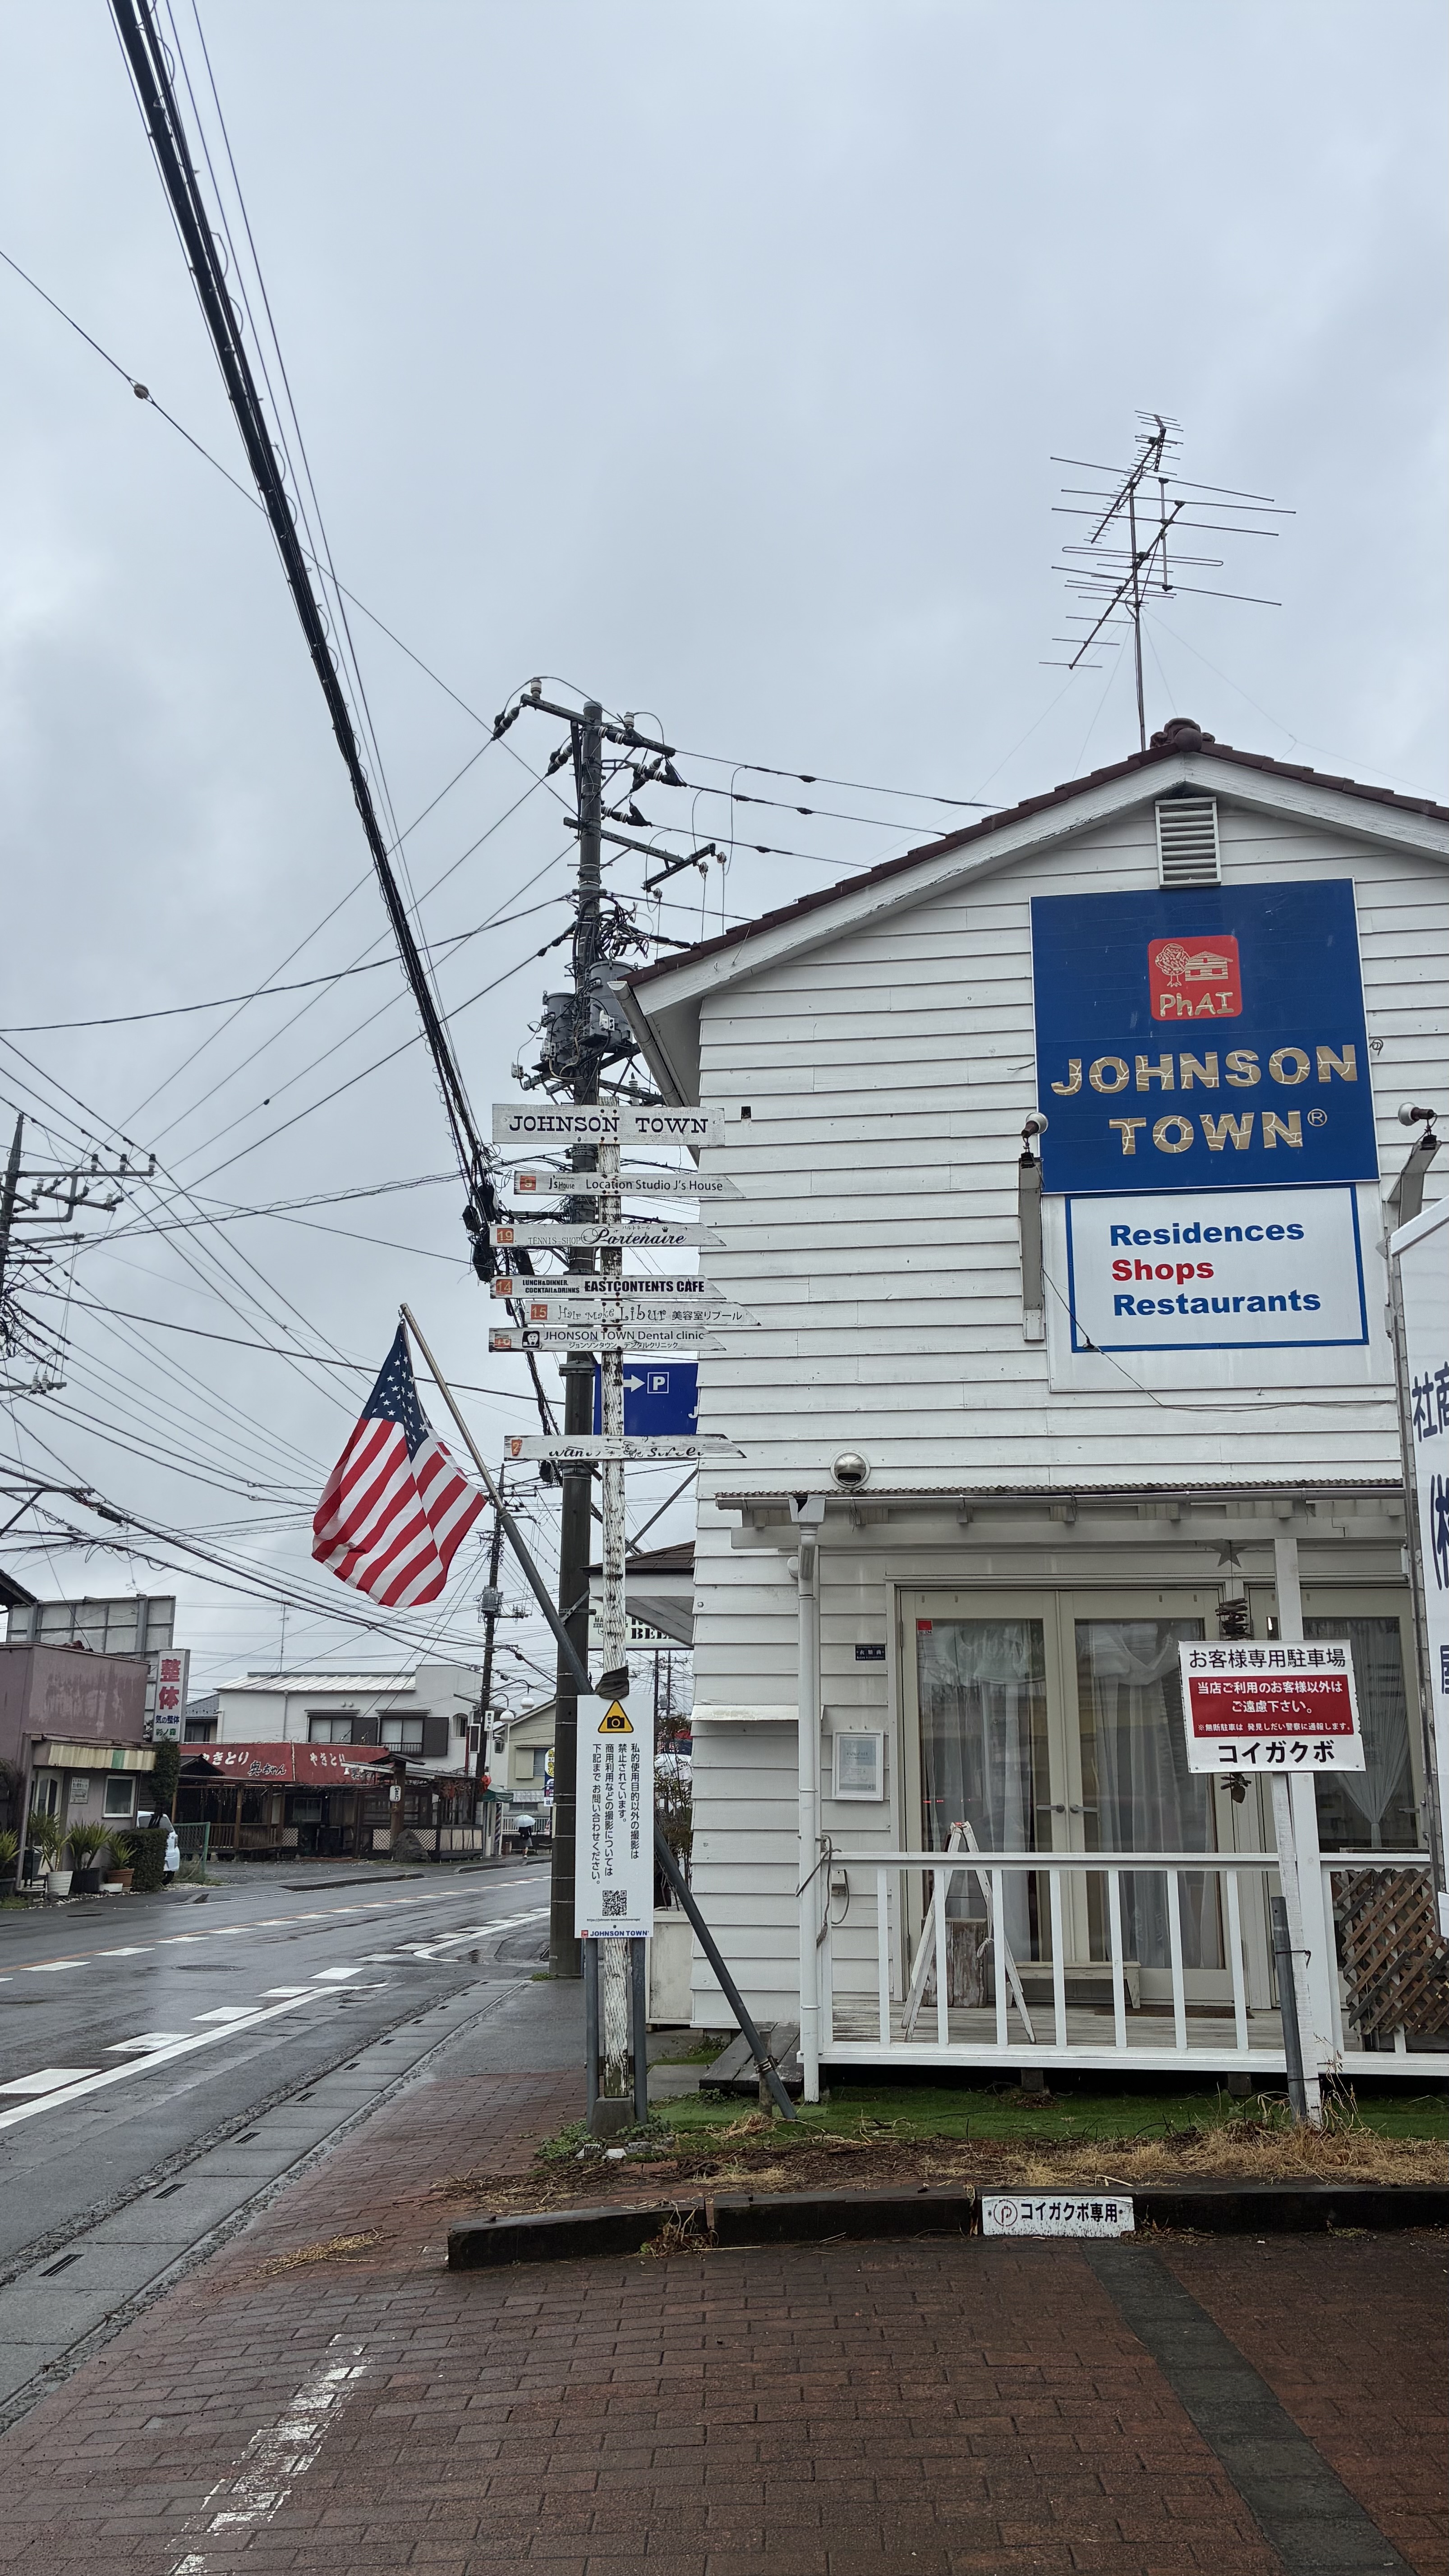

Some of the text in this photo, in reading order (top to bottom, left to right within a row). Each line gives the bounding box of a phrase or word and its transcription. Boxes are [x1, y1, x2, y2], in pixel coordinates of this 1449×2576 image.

[1051, 1044, 1358, 1096] JOHNSON
[510, 1116, 708, 1133] JOHNSON TOWN
[586, 1178, 723, 1191] Location Studio J's House
[498, 1230, 513, 1241] 19
[581, 1226, 687, 1245] Partenaire
[1110, 1222, 1305, 1246] Residences
[1112, 1259, 1214, 1284] Shops
[497, 1282, 512, 1293] 14
[584, 1281, 704, 1293] EASTCONTENTS CAFE
[531, 1307, 547, 1318] 15
[1113, 1289, 1321, 1316] Restaurants
[672, 1311, 742, 1320] 美容室リブール
[544, 1331, 704, 1340] JHONSON TOWN Dental clinic
[1189, 1648, 1346, 1669] お客様専用駐車場
[159, 1659, 181, 1710] 整体
[1198, 1681, 1343, 1694] 当店ご利用のお客様以外は
[1232, 1700, 1312, 1714] ご遠慮下さい。
[1218, 1740, 1336, 1764] コイガクボ
[618, 1743, 627, 1822] 禁止されています。
[605, 1744, 614, 1876] 商用利用などの撮影については
[630, 1743, 640, 1859] 私的使用目的以外の撮影は
[1021, 2202, 1118, 2223] コイガクボ専用
